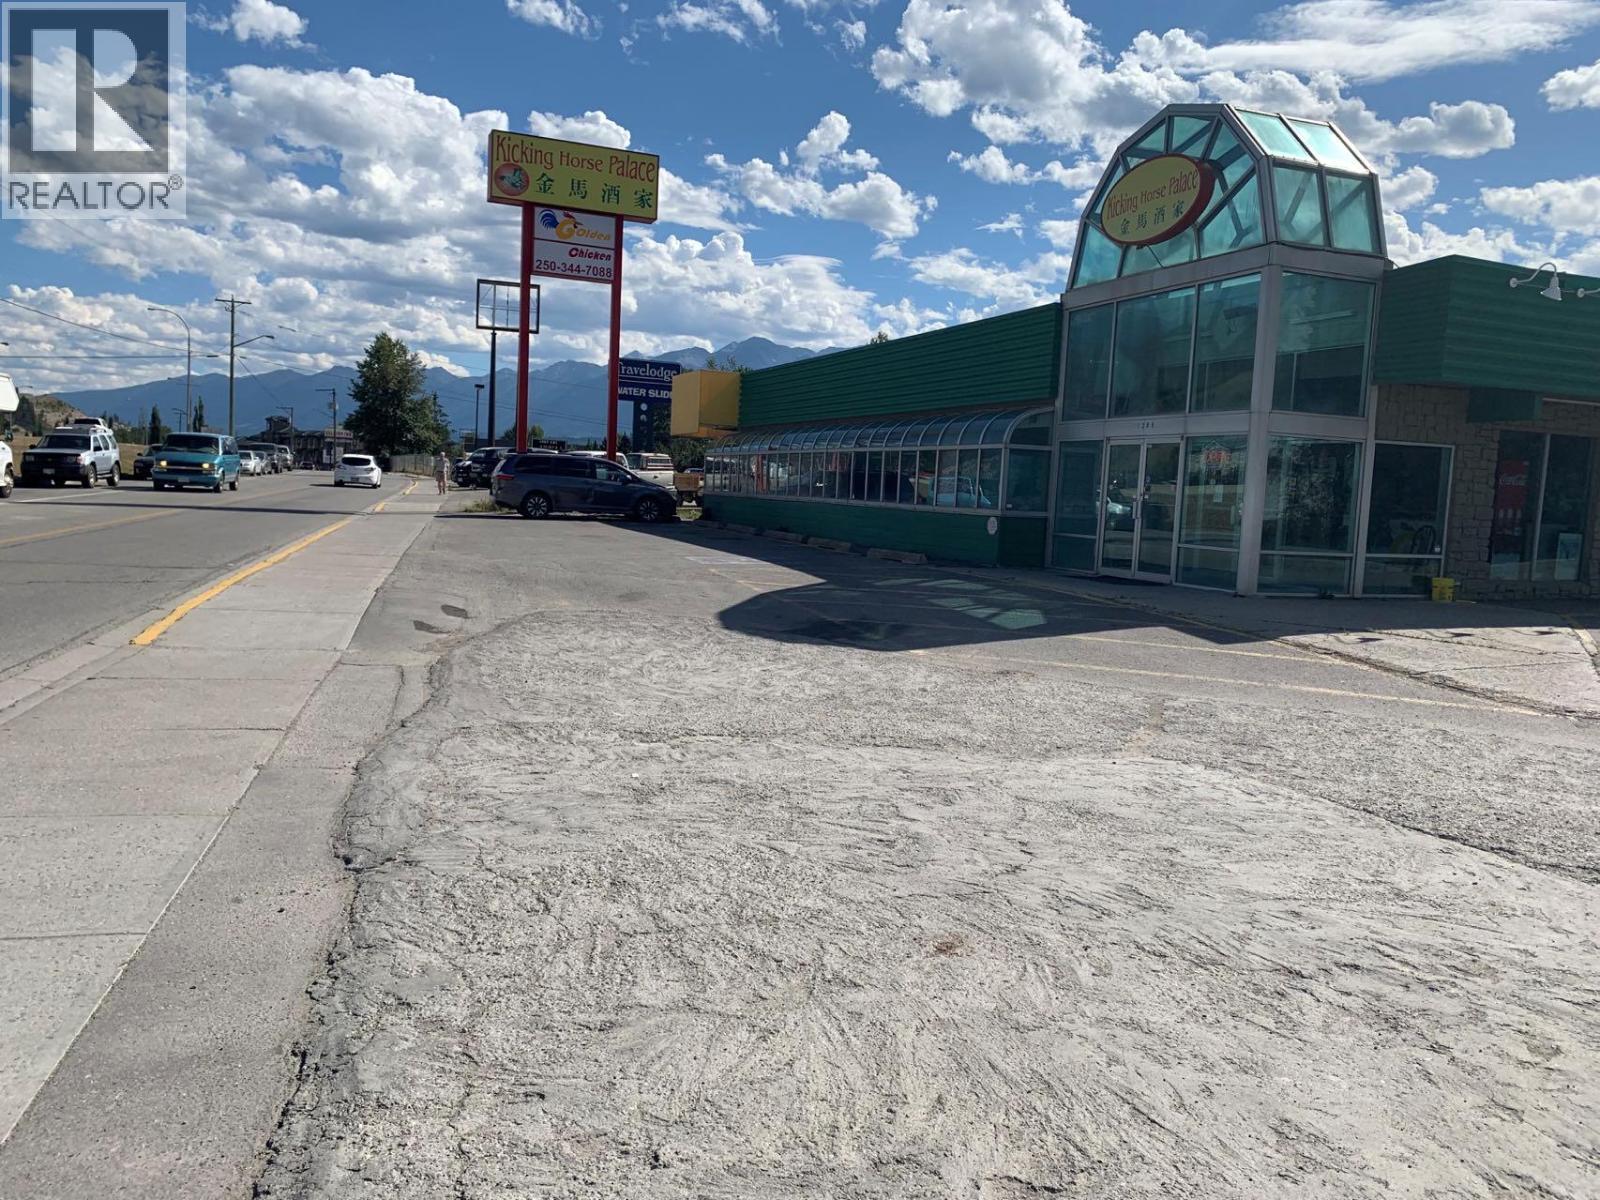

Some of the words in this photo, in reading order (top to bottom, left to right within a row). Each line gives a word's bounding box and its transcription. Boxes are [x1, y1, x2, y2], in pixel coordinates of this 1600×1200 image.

[495, 135, 554, 170] Kicking
[559, 151, 603, 172] Horse
[609, 155, 656, 183] Palace
[1141, 185, 1167, 205] Horse
[1168, 170, 1199, 195] Palace
[568, 247, 612, 261] Chicken
[535, 259, 613, 278] 250-344-7088
[619, 362, 678, 381] ravelodge
[648, 388, 672, 399] SLID
